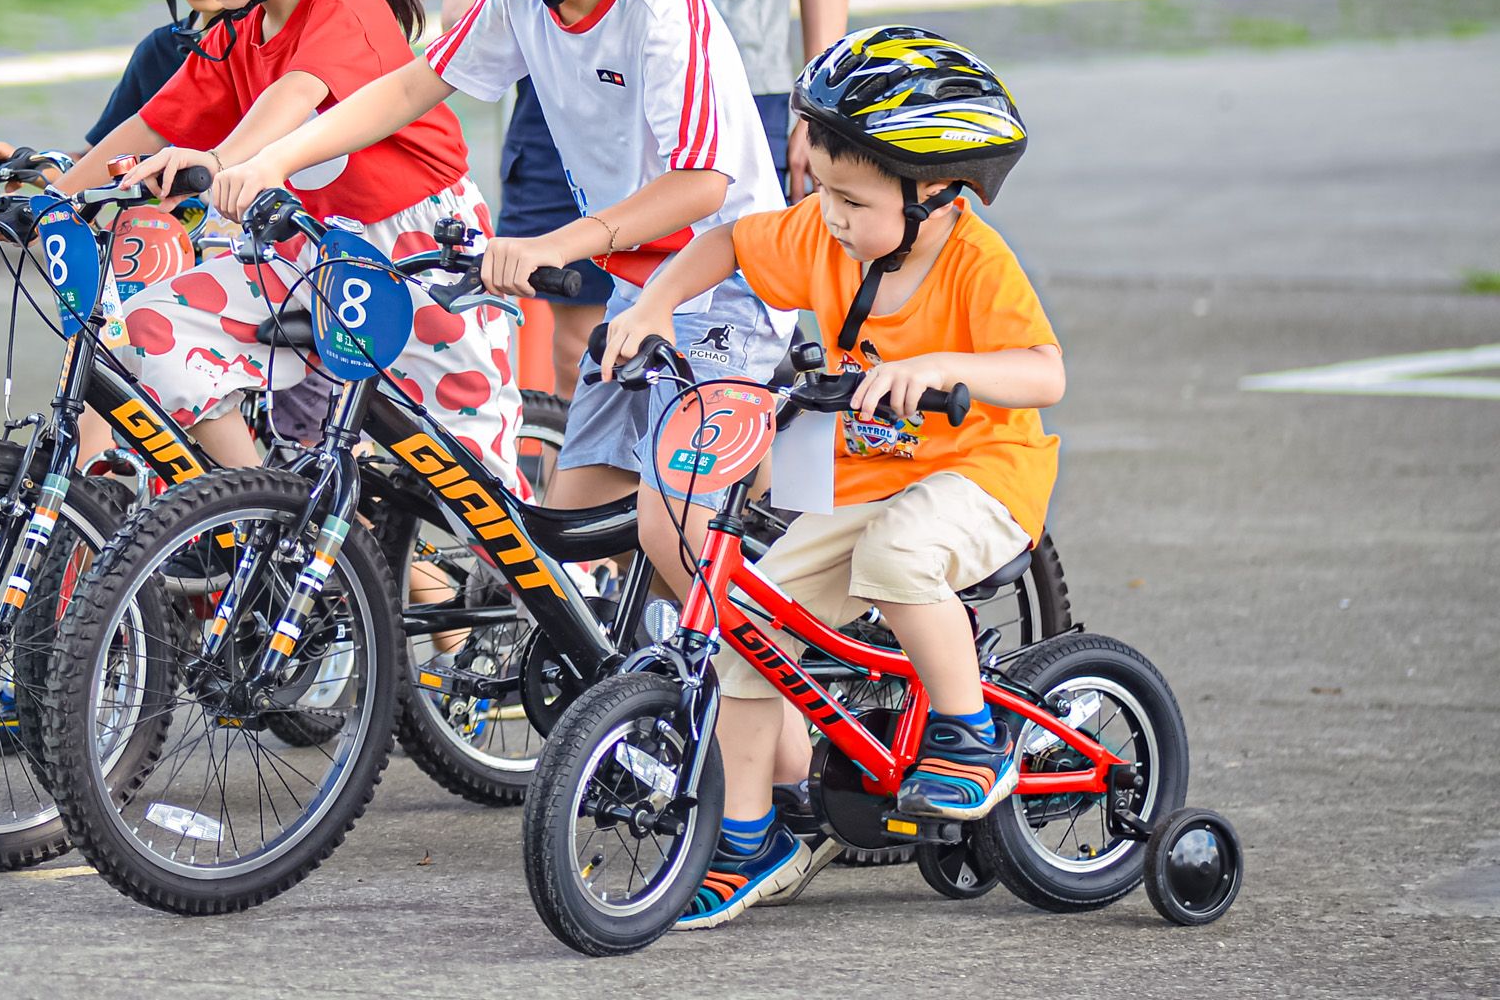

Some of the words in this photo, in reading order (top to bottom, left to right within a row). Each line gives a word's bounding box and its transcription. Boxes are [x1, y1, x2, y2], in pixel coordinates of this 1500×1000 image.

[46, 234, 68, 286] 8
[115, 237, 145, 279] 3
[338, 278, 371, 328] 8
[690, 408, 735, 450] 6
[857, 425, 892, 438] PATROL
[390, 433, 568, 600] GIANT
[730, 622, 845, 726] GIANT
